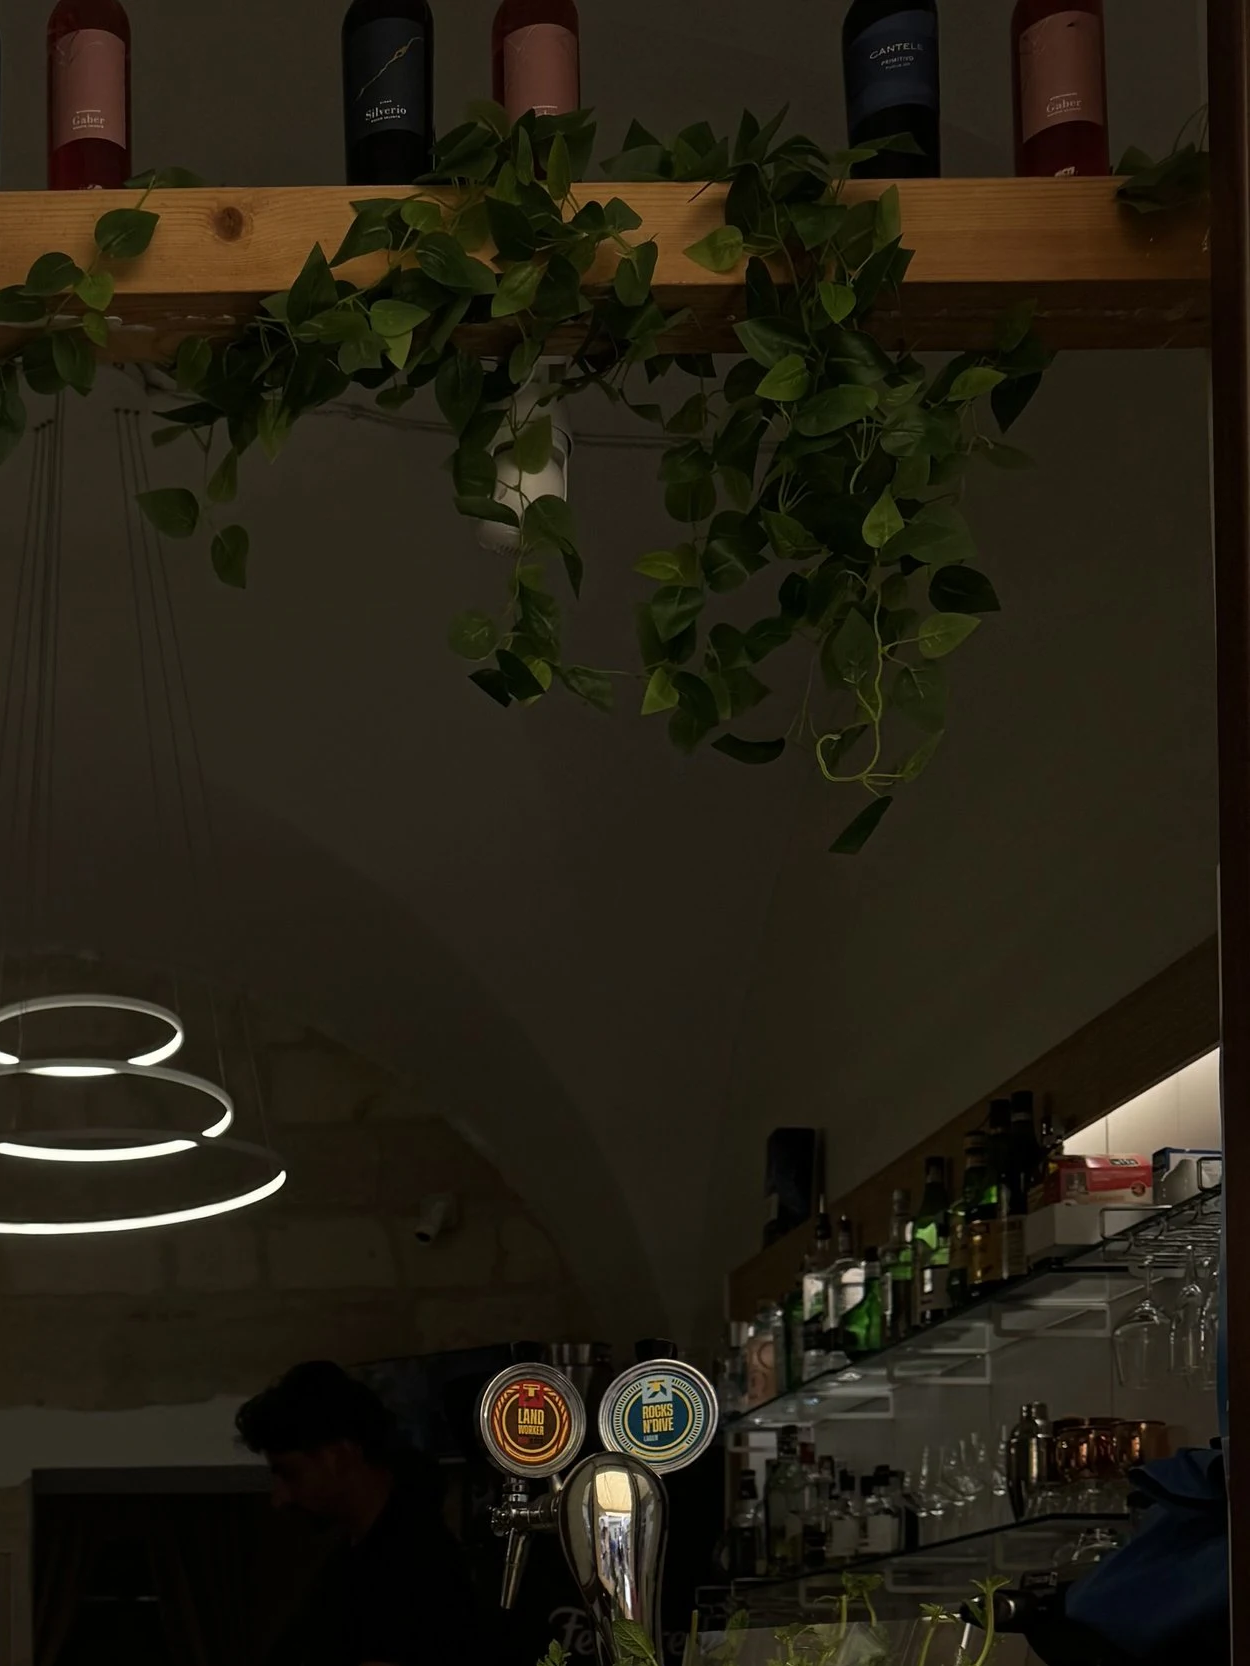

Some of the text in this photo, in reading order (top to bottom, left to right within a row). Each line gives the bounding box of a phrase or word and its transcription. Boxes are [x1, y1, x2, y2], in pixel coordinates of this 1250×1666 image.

[869, 42, 924, 60] CANTELE
[72, 113, 106, 126] Gaber
[365, 105, 407, 121] Silverio
[518, 1408, 545, 1425] LAND
[642, 1402, 674, 1419] ROCKS
[518, 1424, 545, 1436] WORKER
